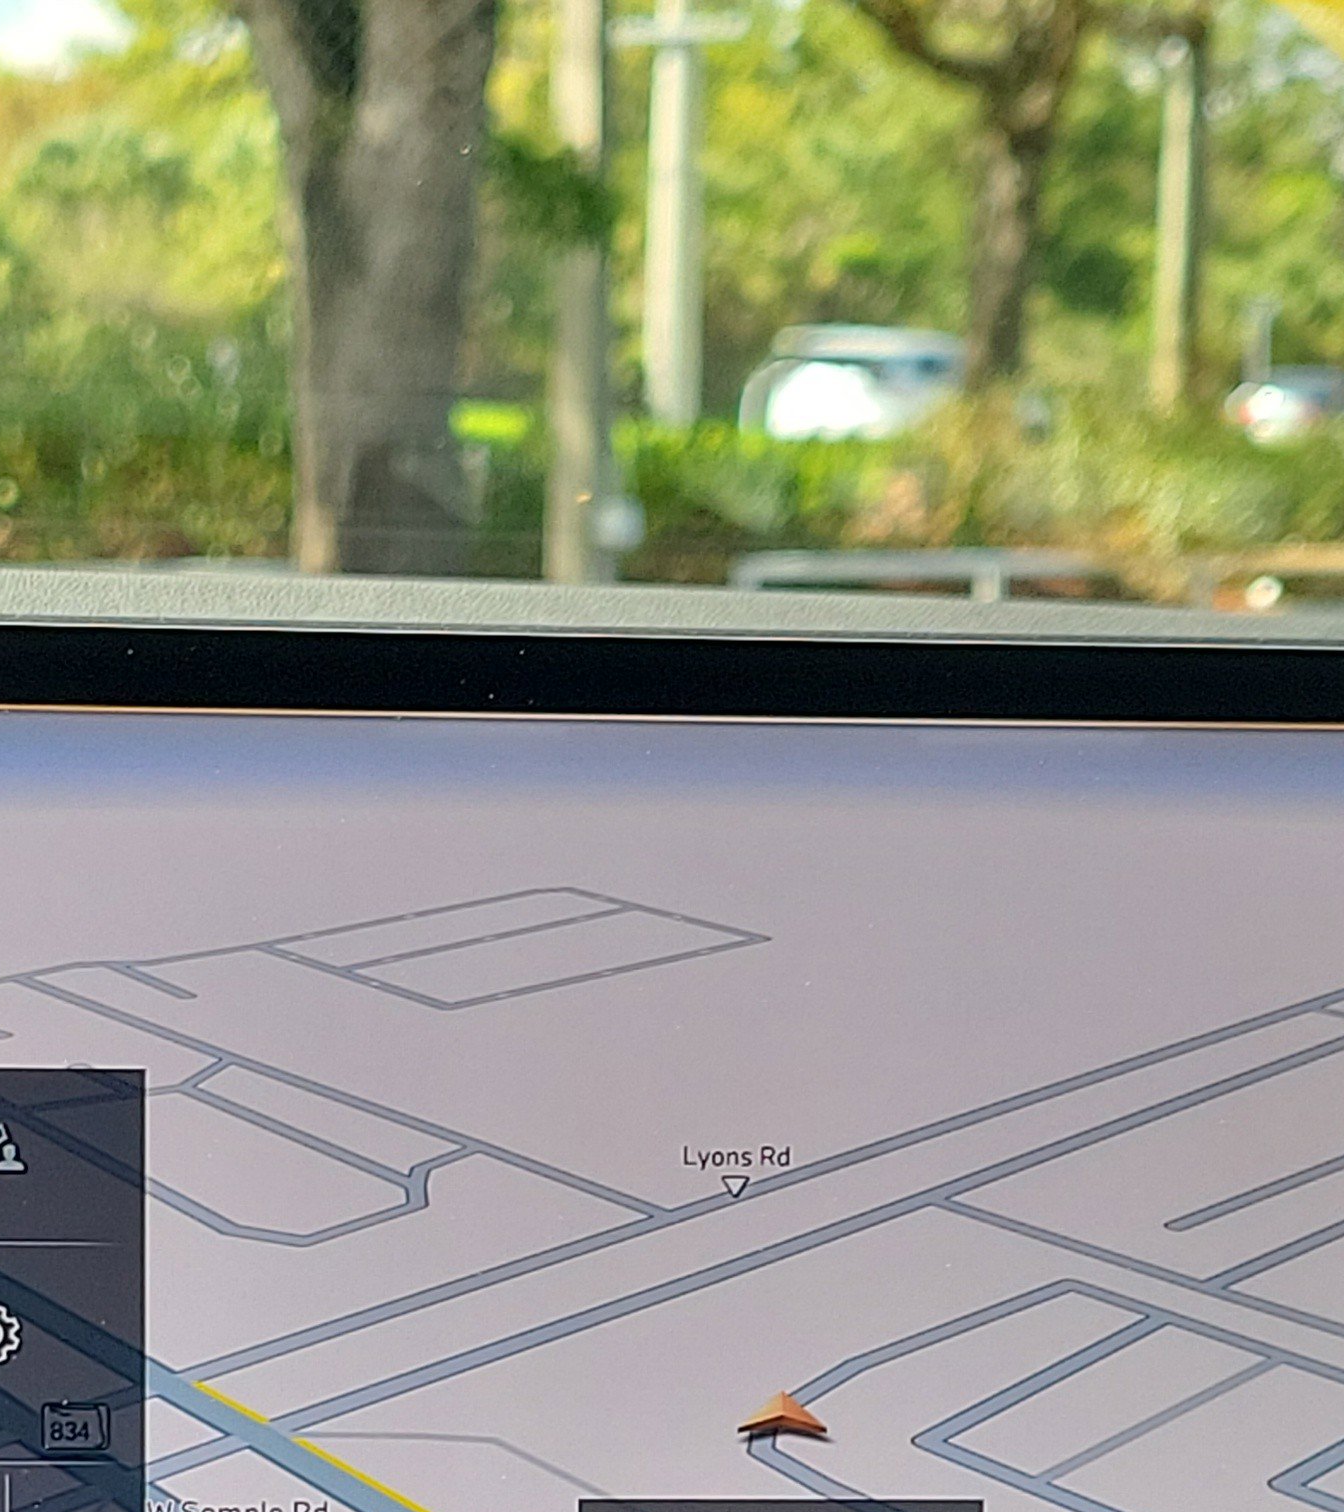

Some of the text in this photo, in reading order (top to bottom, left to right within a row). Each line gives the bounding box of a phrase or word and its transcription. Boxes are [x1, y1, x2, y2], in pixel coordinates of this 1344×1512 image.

[682, 1146, 791, 1169] Lyons Rd
[49, 1421, 89, 1441] 834
